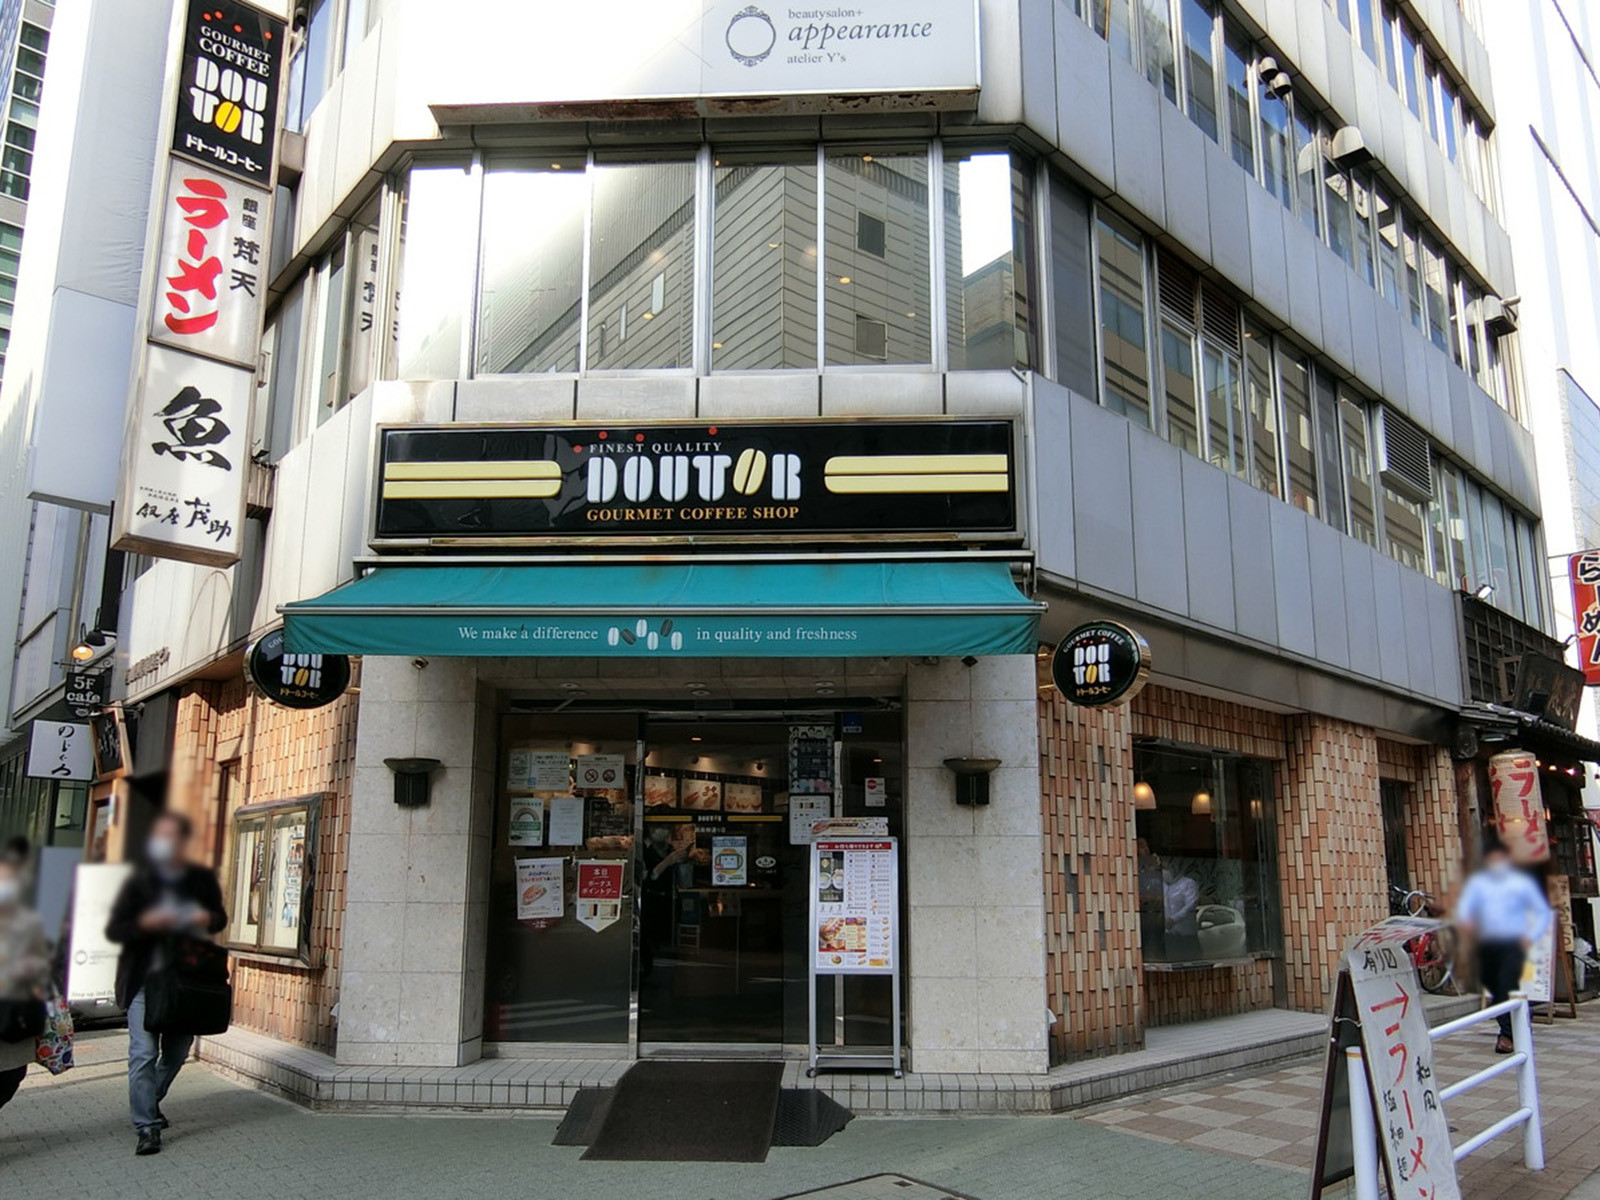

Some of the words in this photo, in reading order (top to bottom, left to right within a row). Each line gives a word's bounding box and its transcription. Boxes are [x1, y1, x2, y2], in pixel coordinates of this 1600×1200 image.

[201, 25, 272, 63] GOURMET
[788, 22, 932, 50] appearance
[199, 37, 270, 77] COFFEE
[787, 54, 822, 64] atelier
[827, 53, 847, 63] Y's
[185, 133, 263, 172] ドトールコーヒー
[165, 178, 229, 335] ラーメン
[152, 386, 232, 471] 魚
[590, 443, 645, 453] FINEST
[652, 442, 722, 454] QUALITY
[587, 448, 801, 503] DOUTOR
[586, 508, 675, 521] GOURMET
[680, 507, 748, 520] COFFEE
[753, 506, 799, 520] SHOP
[459, 627, 478, 640] We
[482, 627, 517, 640] make
[521, 630, 529, 640] a
[533, 626, 599, 640] difference
[697, 627, 711, 640] in
[714, 627, 763, 643] quality
[766, 626, 791, 640] and
[796, 626, 858, 641] freshness
[1097, 629, 1126, 645] COFFEE
[74, 676, 96, 690] 5F
[66, 691, 101, 703] cafe
[1508, 760, 1547, 858] ラーメン
[593, 867, 609, 876] 本日
